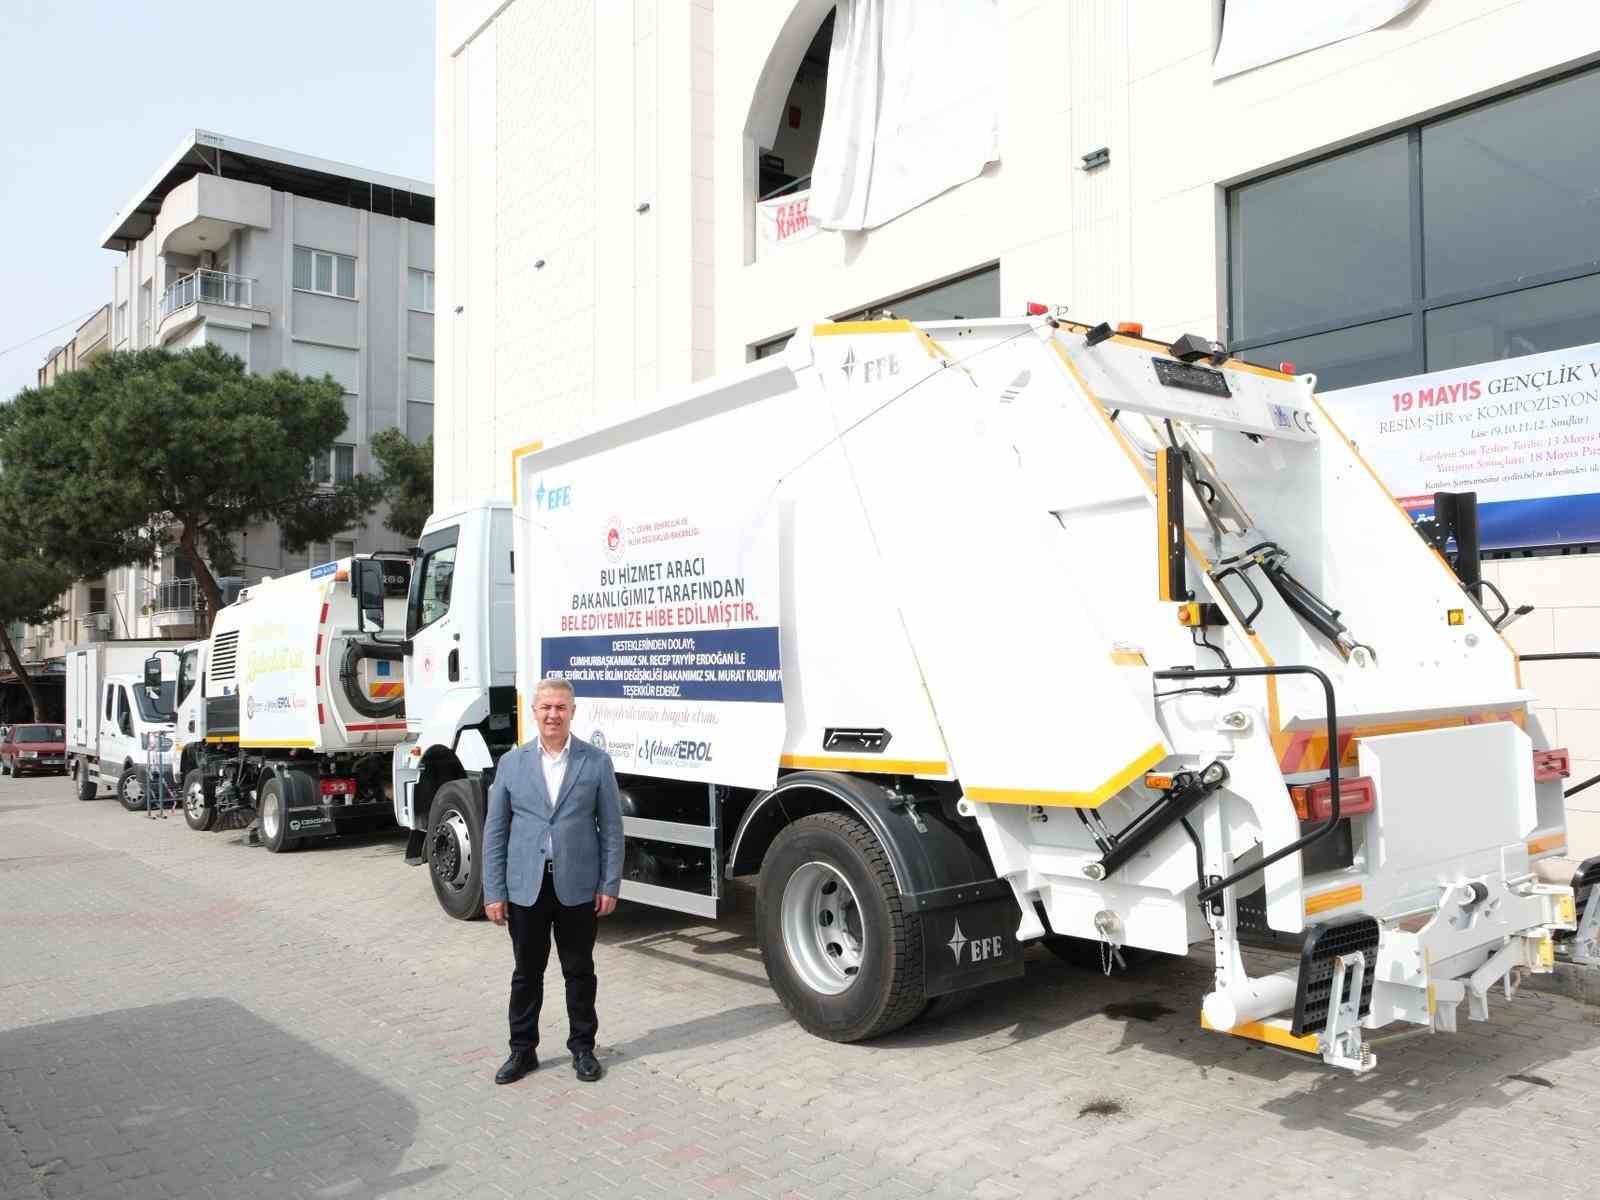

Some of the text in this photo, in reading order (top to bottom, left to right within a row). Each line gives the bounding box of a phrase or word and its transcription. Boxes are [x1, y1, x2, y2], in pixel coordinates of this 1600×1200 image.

[1392, 391, 1414, 412] 19
[1418, 380, 1482, 409] MAYIS
[1487, 363, 1584, 395] GENÇLİK
[600, 557, 705, 587] BU HİZMET ARACI
[571, 577, 745, 610] BAKANLIĞIMIZ TARAFINDAN
[645, 605, 674, 627] HİBE
[677, 599, 759, 627] EDİLMİŞTİR.
[649, 654, 671, 666] RECEP
[695, 651, 734, 665] ERDOĞAN
[663, 669, 704, 681] BAKANIMIZ
[718, 668, 746, 681] MURAT
[679, 740, 713, 762] EROL
[970, 935, 1003, 962] EFE
